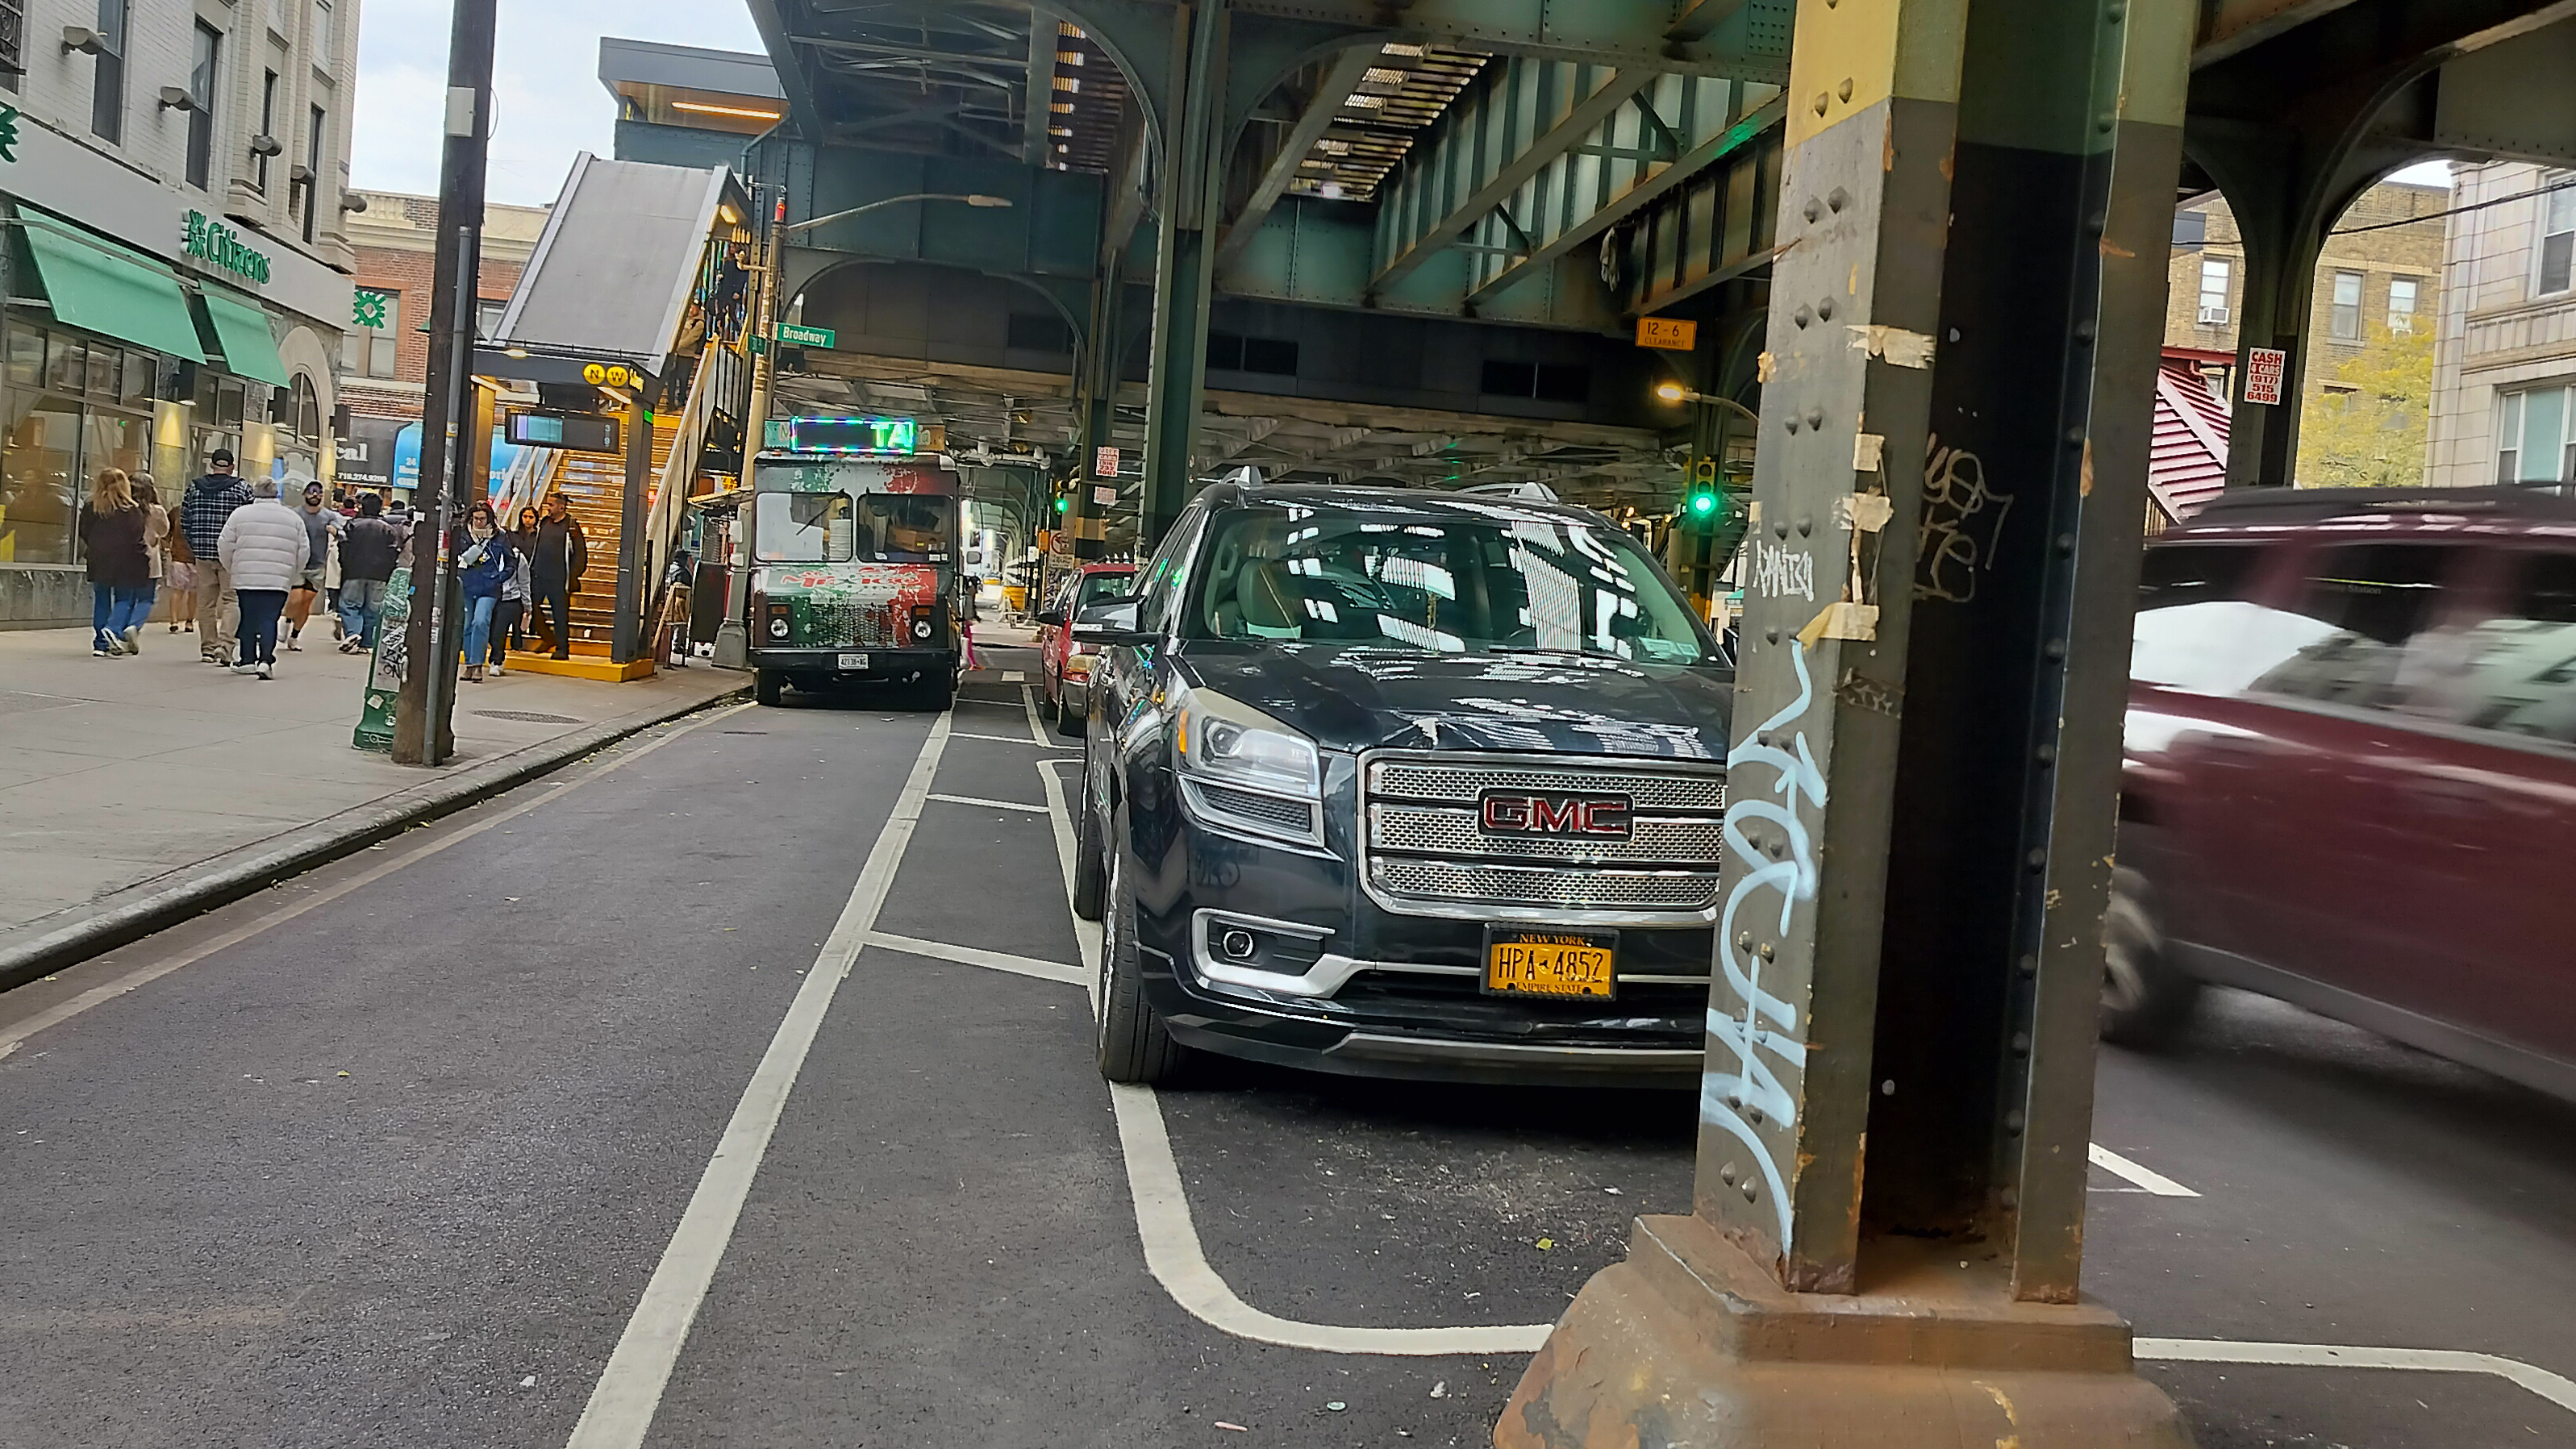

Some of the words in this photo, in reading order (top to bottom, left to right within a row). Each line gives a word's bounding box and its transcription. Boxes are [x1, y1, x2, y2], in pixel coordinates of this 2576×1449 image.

[207, 223, 271, 284] Citizens
[1647, 322, 1659, 335] 12
[1672, 325, 1679, 337] 6
[783, 327, 827, 347] Broadway
[590, 369, 599, 380] N
[611, 371, 624, 382] W
[2251, 364, 2257, 373] 4
[2259, 364, 2280, 376] CARS
[2250, 375, 2278, 385] (917)
[2253, 384, 2274, 393] 515
[2247, 392, 2278, 402] 6499
[1484, 795, 1628, 835] GMC
[1519, 934, 1549, 944] NEW
[1553, 935, 1586, 946] YORK
[1516, 981, 1549, 991] EMPIRE
[1554, 984, 1582, 993] STATE
